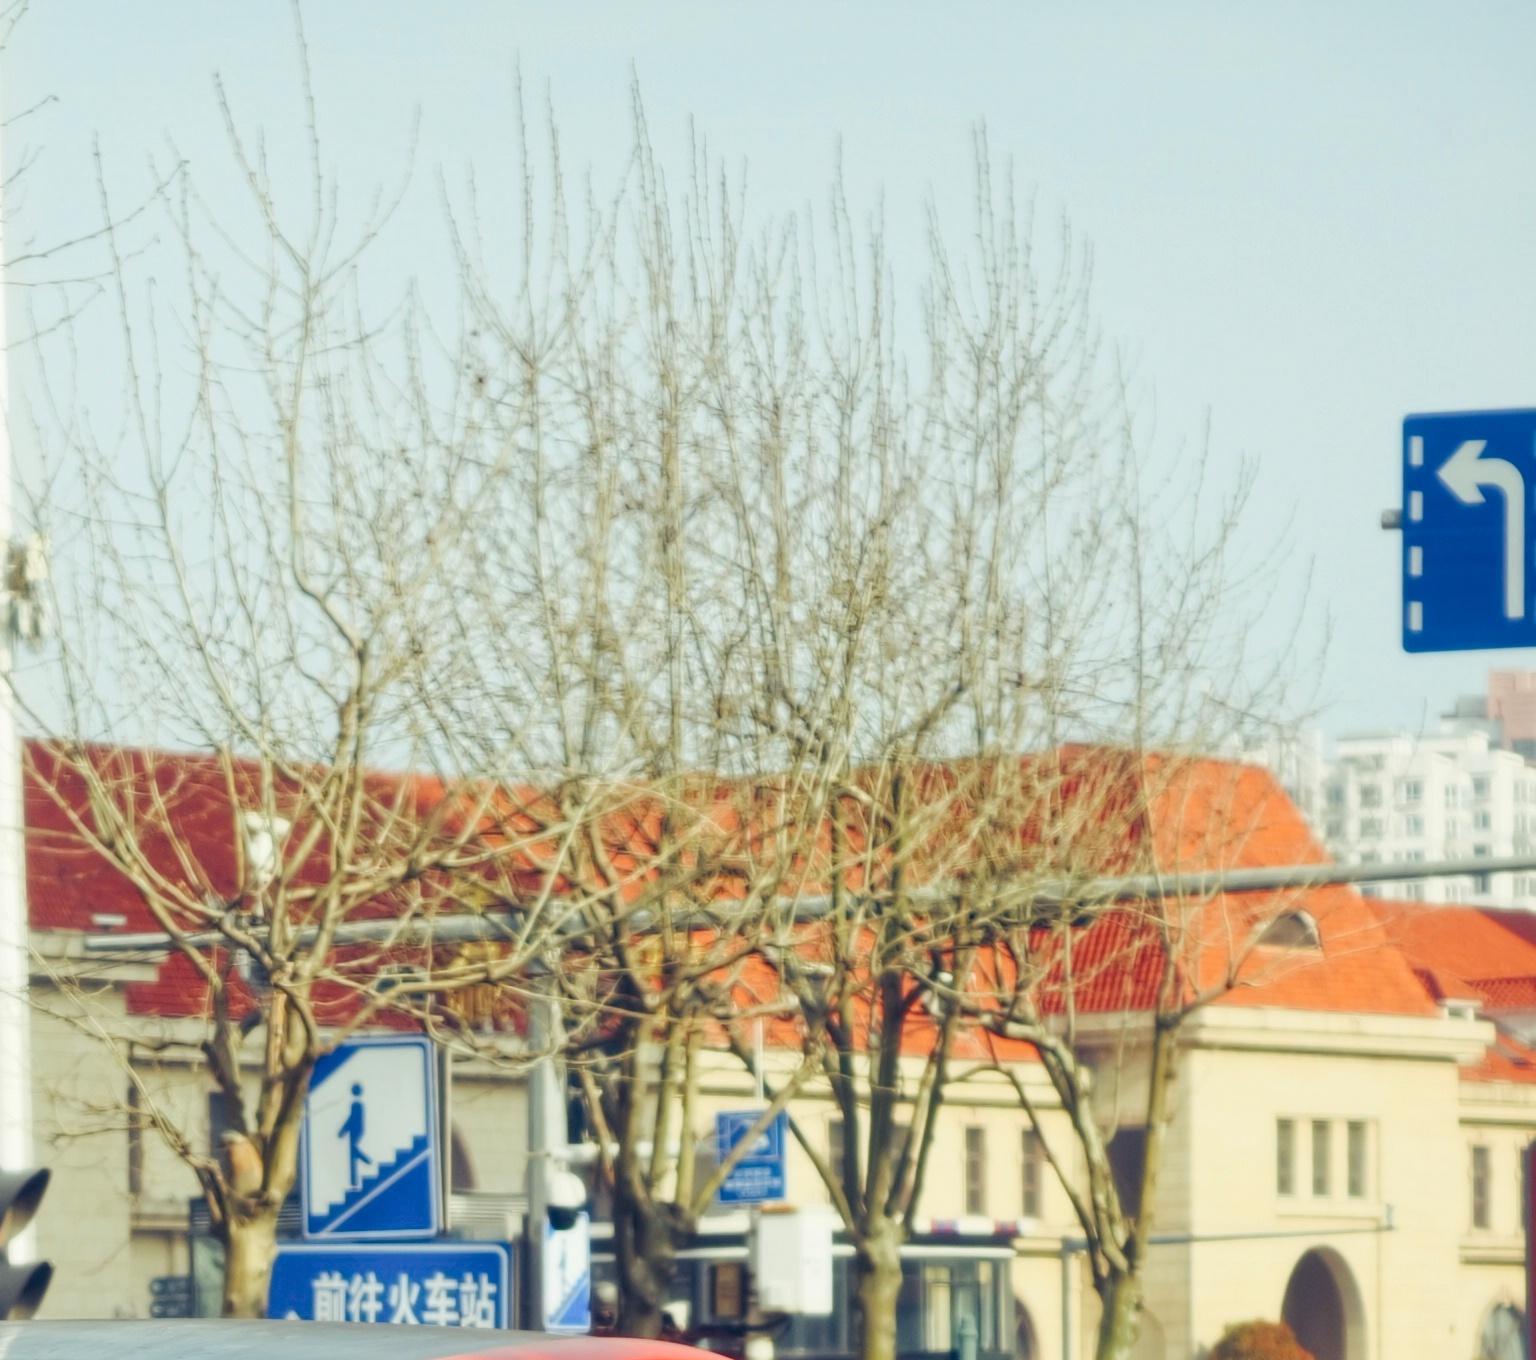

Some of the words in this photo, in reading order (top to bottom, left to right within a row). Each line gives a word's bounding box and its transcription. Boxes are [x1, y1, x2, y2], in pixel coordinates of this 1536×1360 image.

[312, 1270, 497, 1329] 前往火车站
